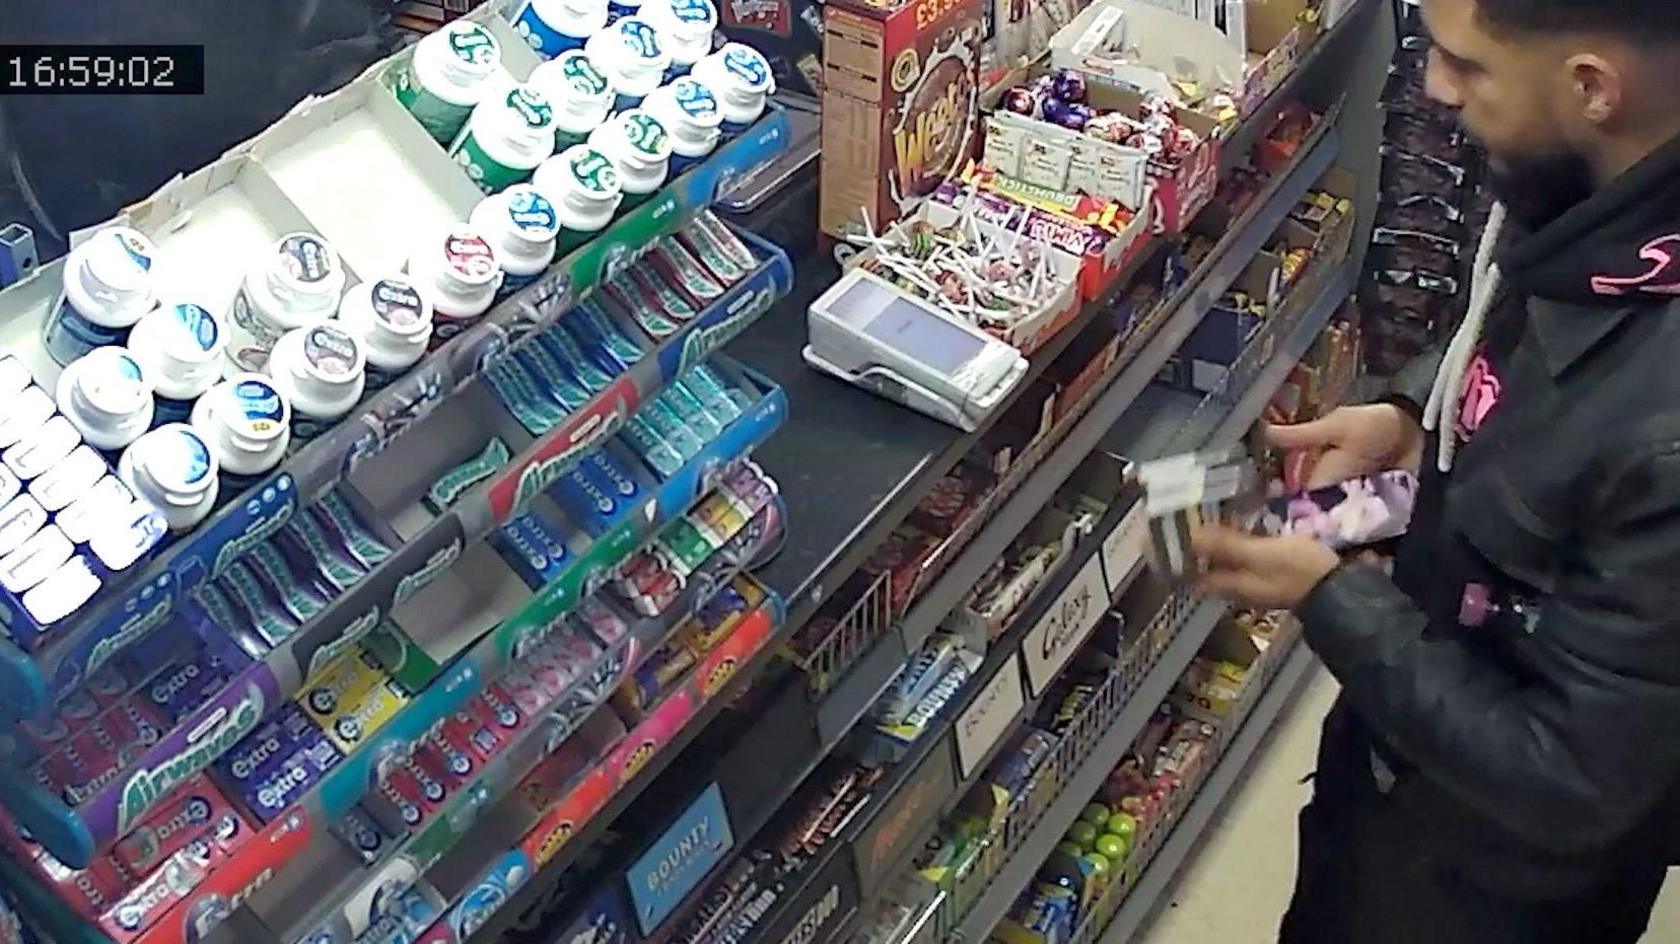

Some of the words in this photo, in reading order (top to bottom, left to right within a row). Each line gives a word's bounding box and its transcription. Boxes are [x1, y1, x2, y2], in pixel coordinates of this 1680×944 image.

[120, 680, 263, 836] Airwaves
[229, 737, 282, 779] extra
[257, 765, 308, 808] extra
[646, 815, 711, 891] BOUNTY
